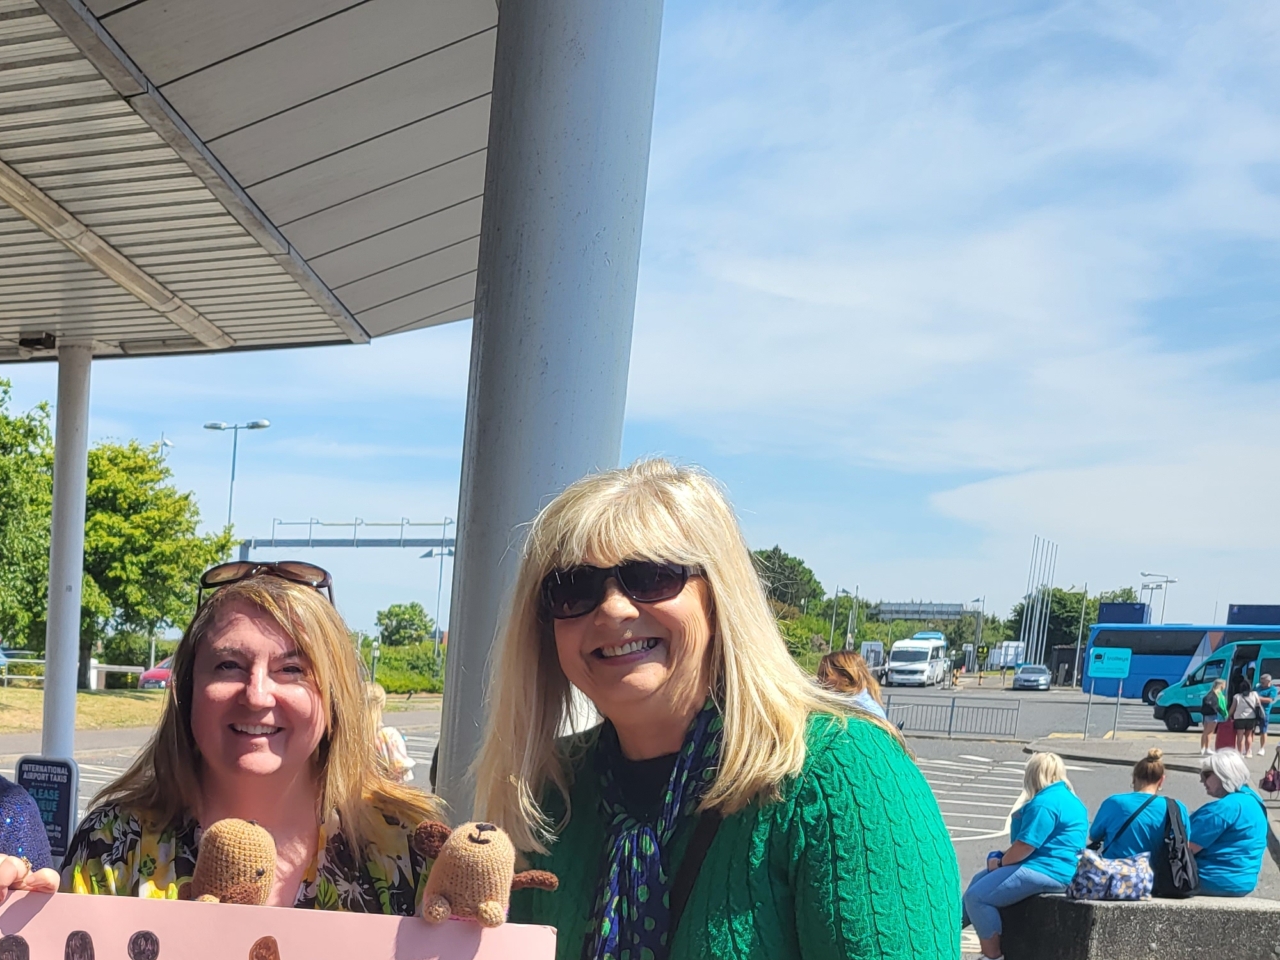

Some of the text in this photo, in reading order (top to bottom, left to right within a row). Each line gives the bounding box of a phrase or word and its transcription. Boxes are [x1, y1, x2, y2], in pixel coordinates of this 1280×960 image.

[21, 763, 69, 775] INTERNATIONAL
[23, 771, 67, 783] AIRPORT TAXIS
[28, 788, 60, 800] PLEASE
[38, 800, 58, 811] EUE
